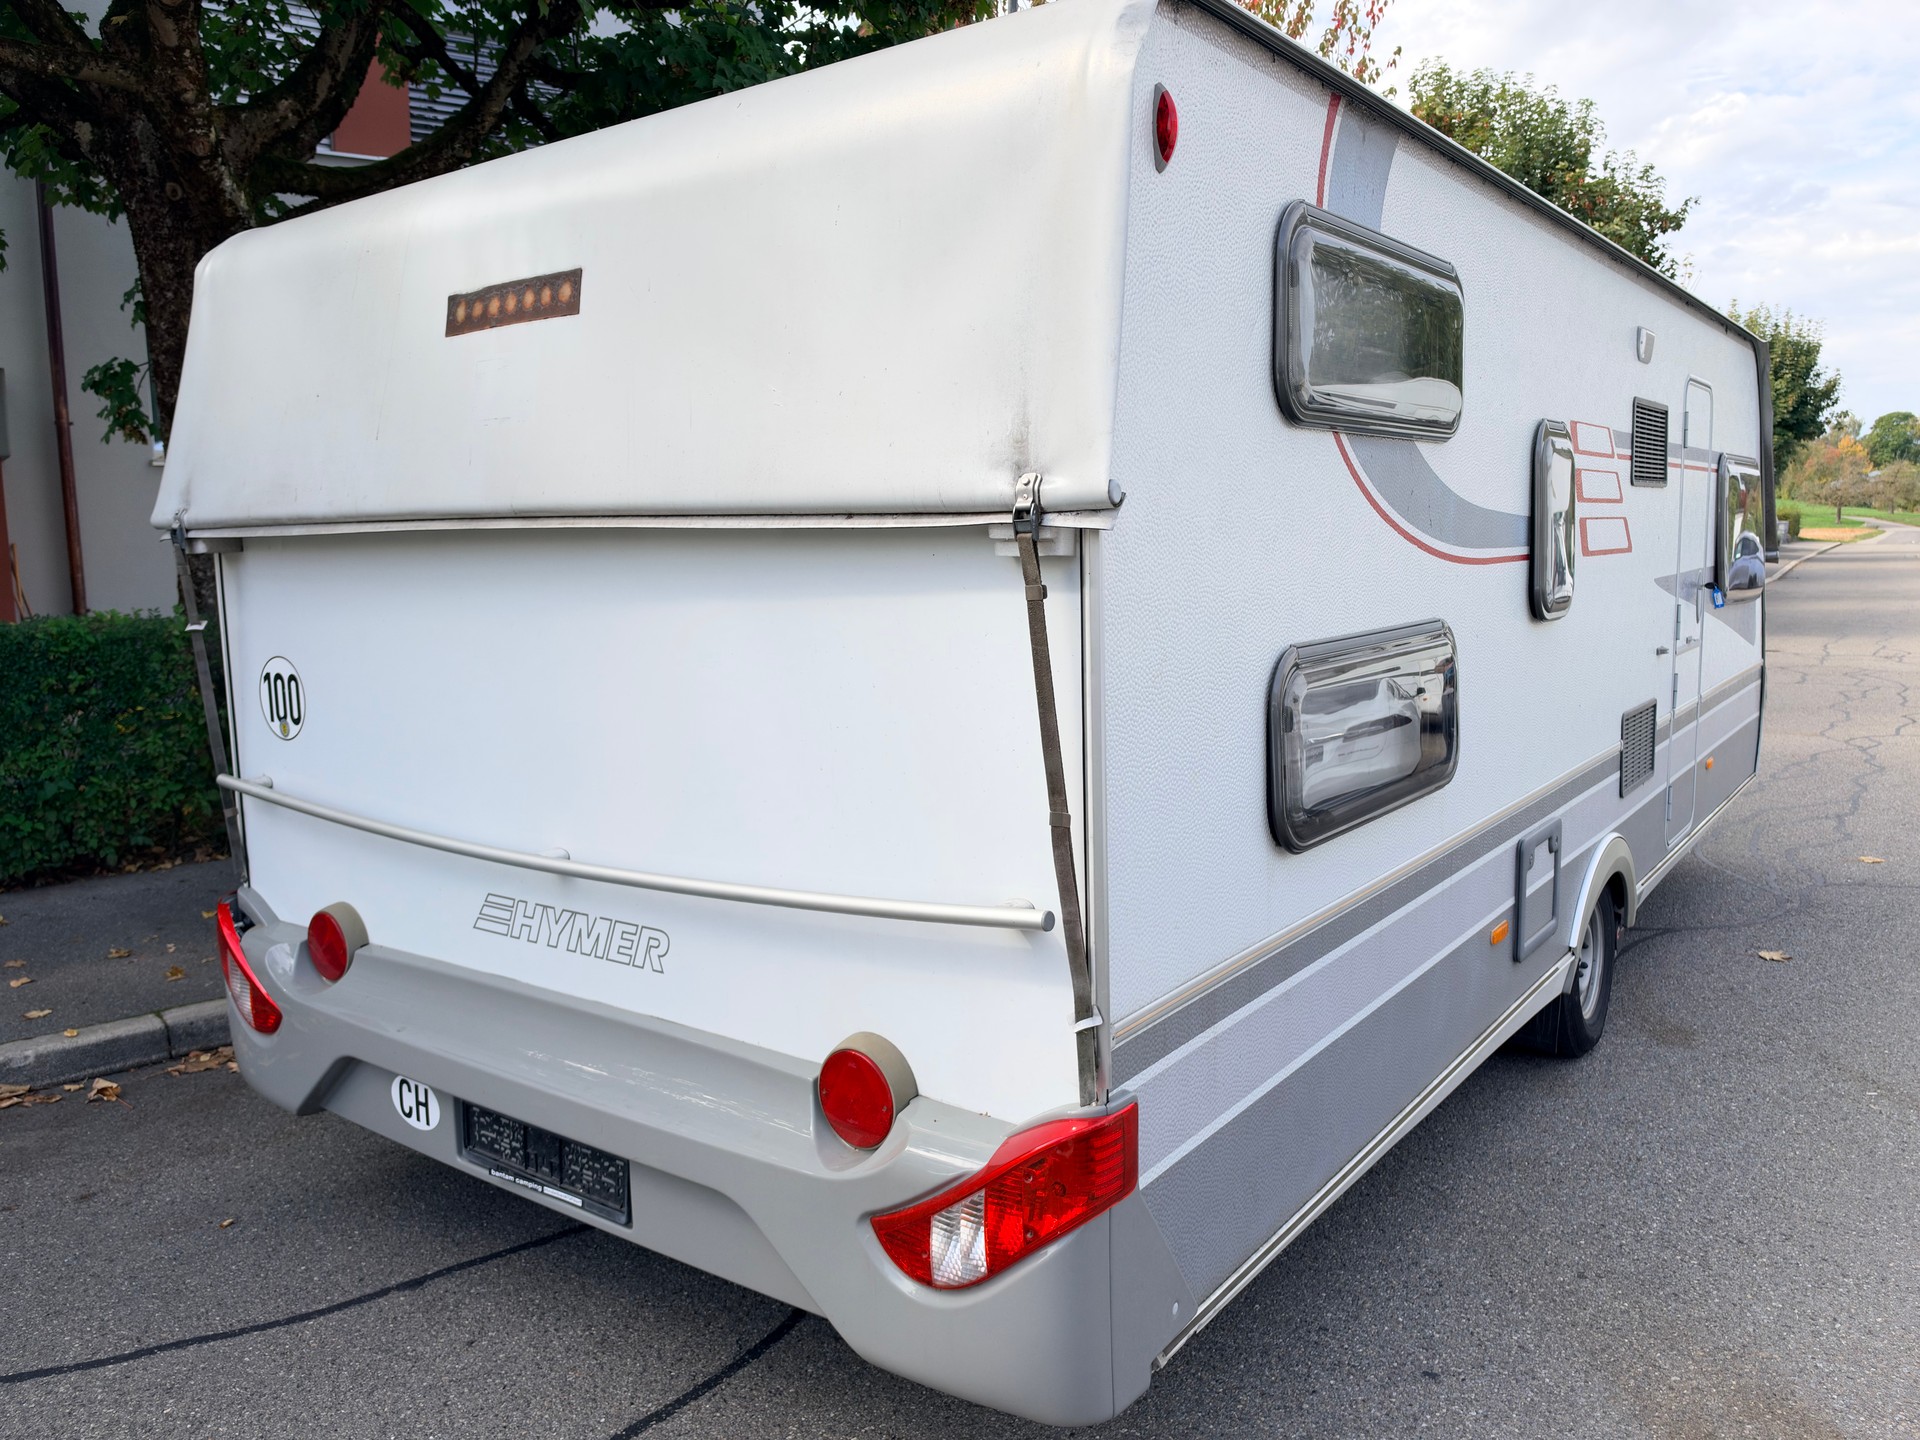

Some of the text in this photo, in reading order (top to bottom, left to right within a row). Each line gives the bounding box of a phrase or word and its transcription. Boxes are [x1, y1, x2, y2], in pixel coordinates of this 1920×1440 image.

[263, 672, 301, 726] 100
[509, 899, 671, 974] HYMER
[399, 1078, 430, 1127] CH
[491, 1168, 543, 1192] bantam camping
